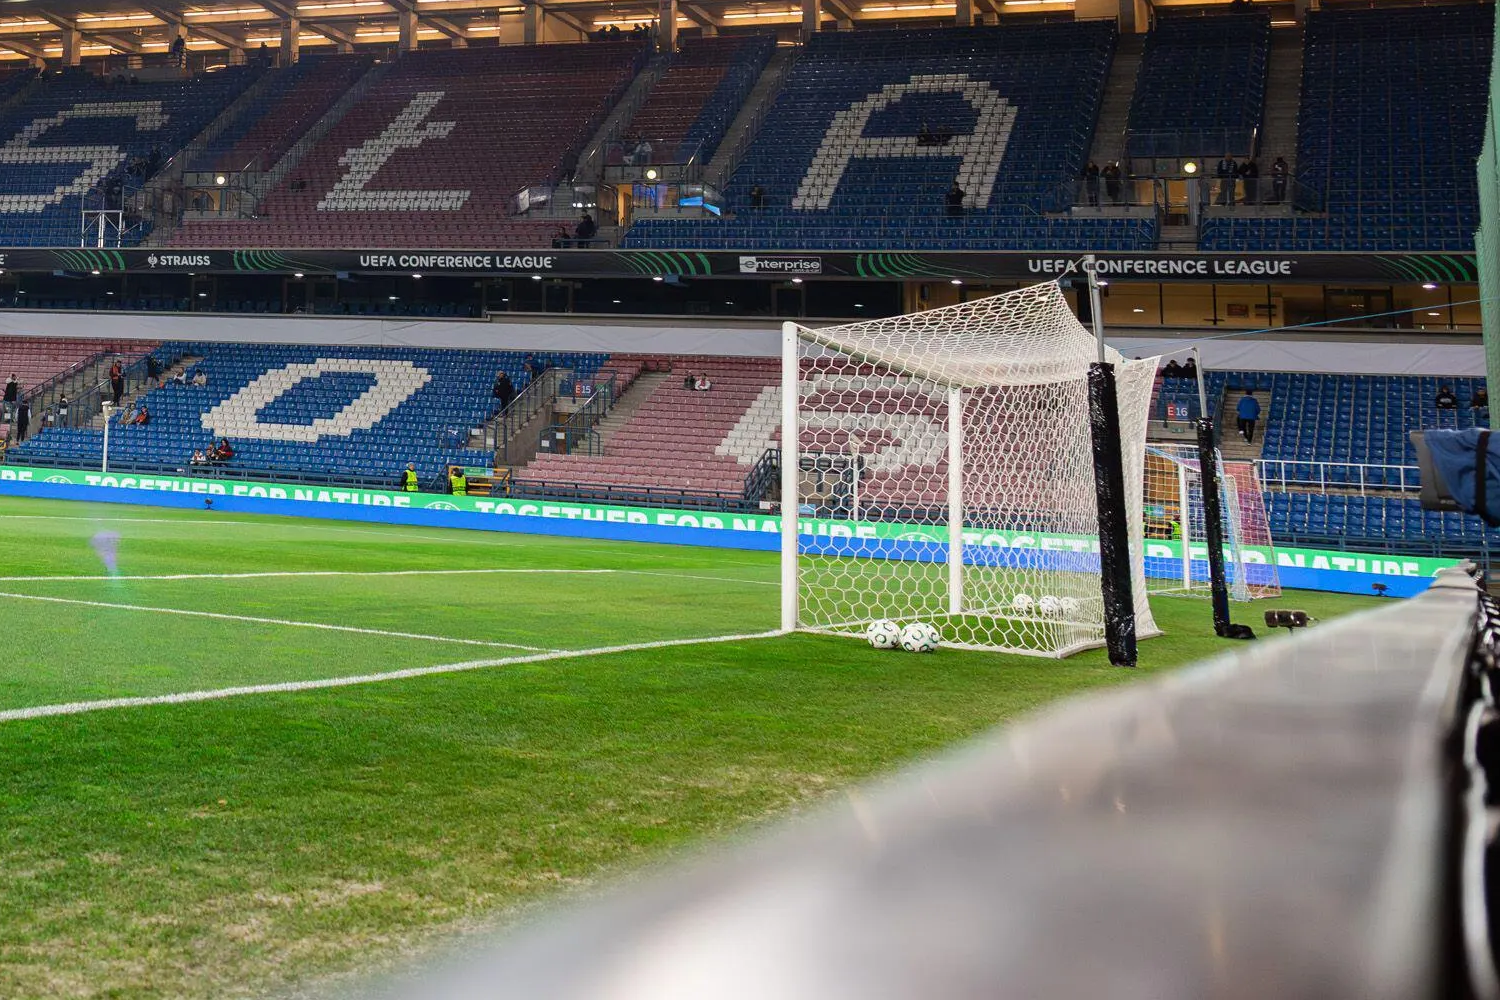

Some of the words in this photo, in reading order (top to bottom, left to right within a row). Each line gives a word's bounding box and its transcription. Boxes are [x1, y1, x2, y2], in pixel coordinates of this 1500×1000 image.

[160, 255, 211, 266] STRAUSS
[359, 255, 396, 267] UEFA
[399, 256, 491, 268] CONFERENCE
[496, 256, 552, 268] LEAGUE
[744, 260, 820, 271] enterprise
[1028, 259, 1078, 273] UEFA
[1213, 260, 1291, 275] LEAGUE
[1167, 406, 1175, 416] E
[1176, 407, 1188, 416] 16
